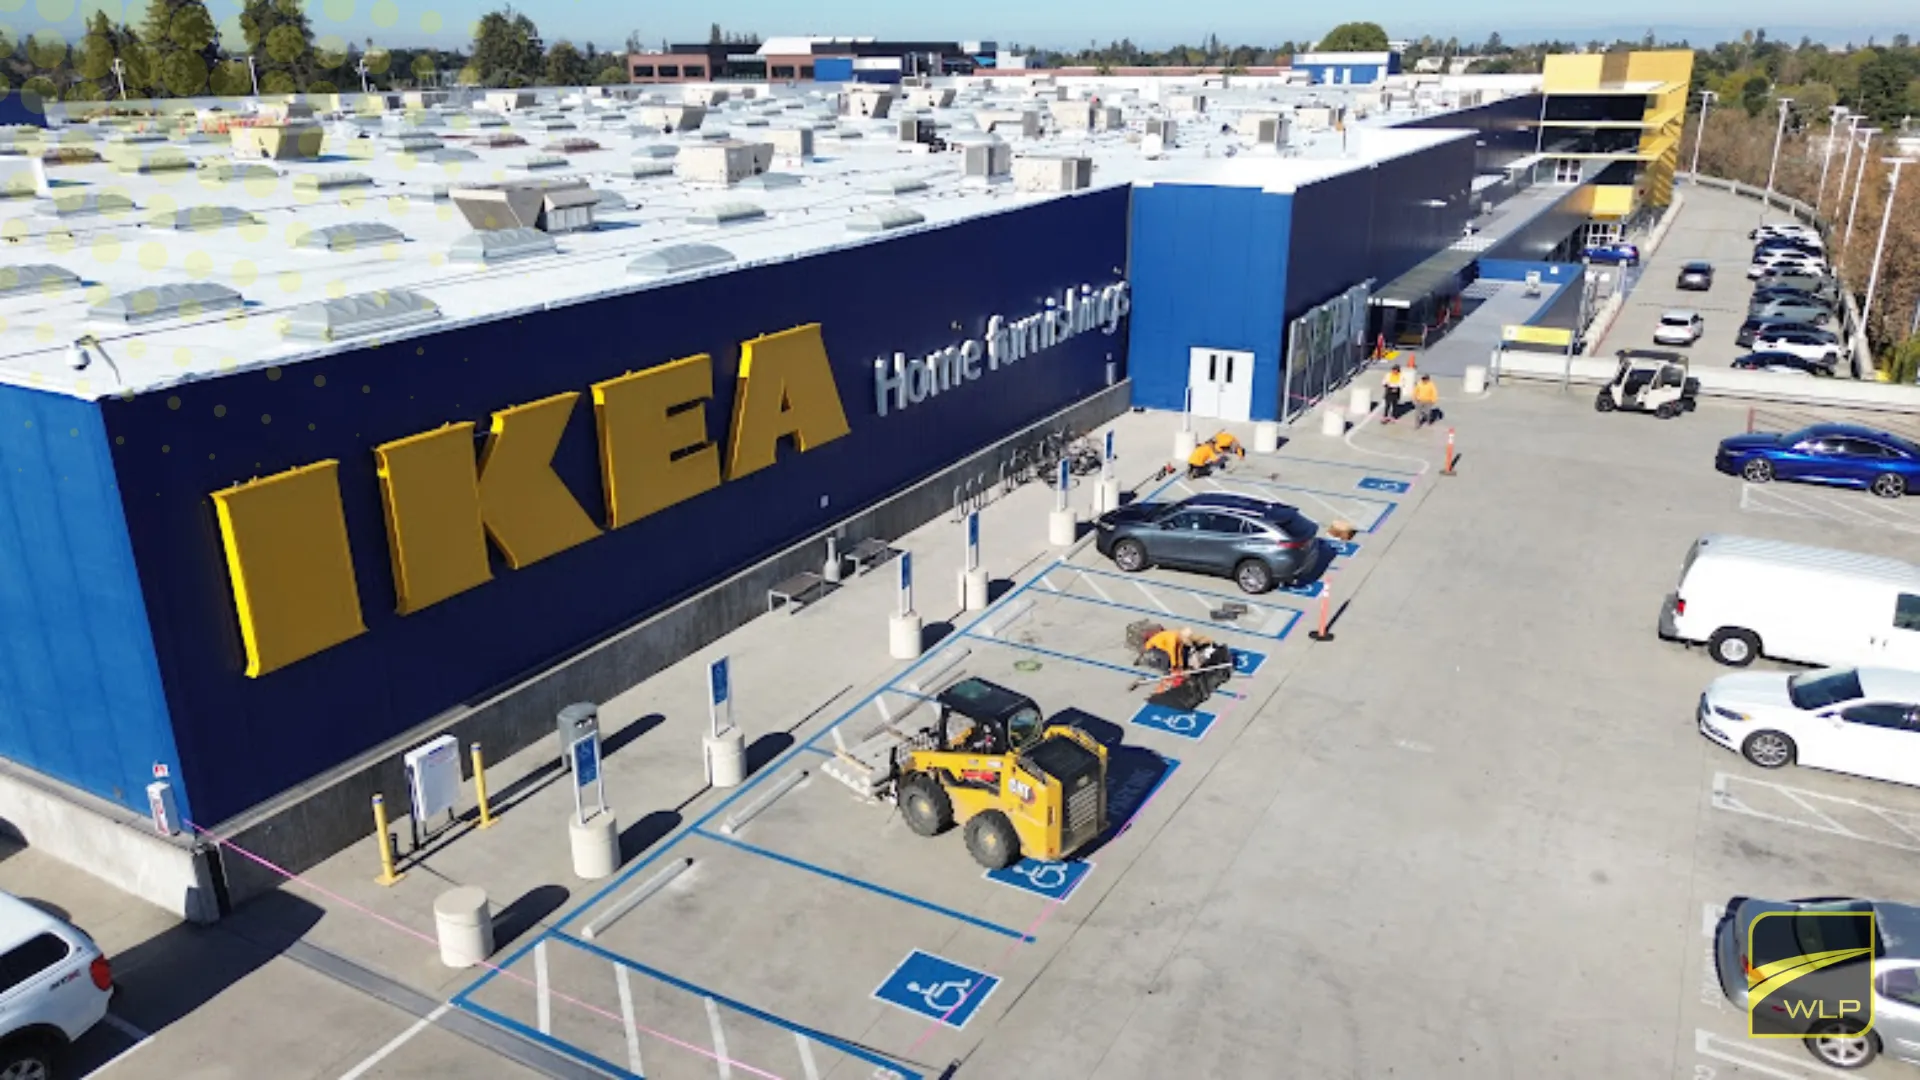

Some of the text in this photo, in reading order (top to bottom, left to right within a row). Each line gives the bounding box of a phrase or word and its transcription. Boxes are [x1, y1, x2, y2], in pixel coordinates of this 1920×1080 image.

[874, 280, 1130, 417] Home furnishings
[209, 322, 851, 678] IKEA
